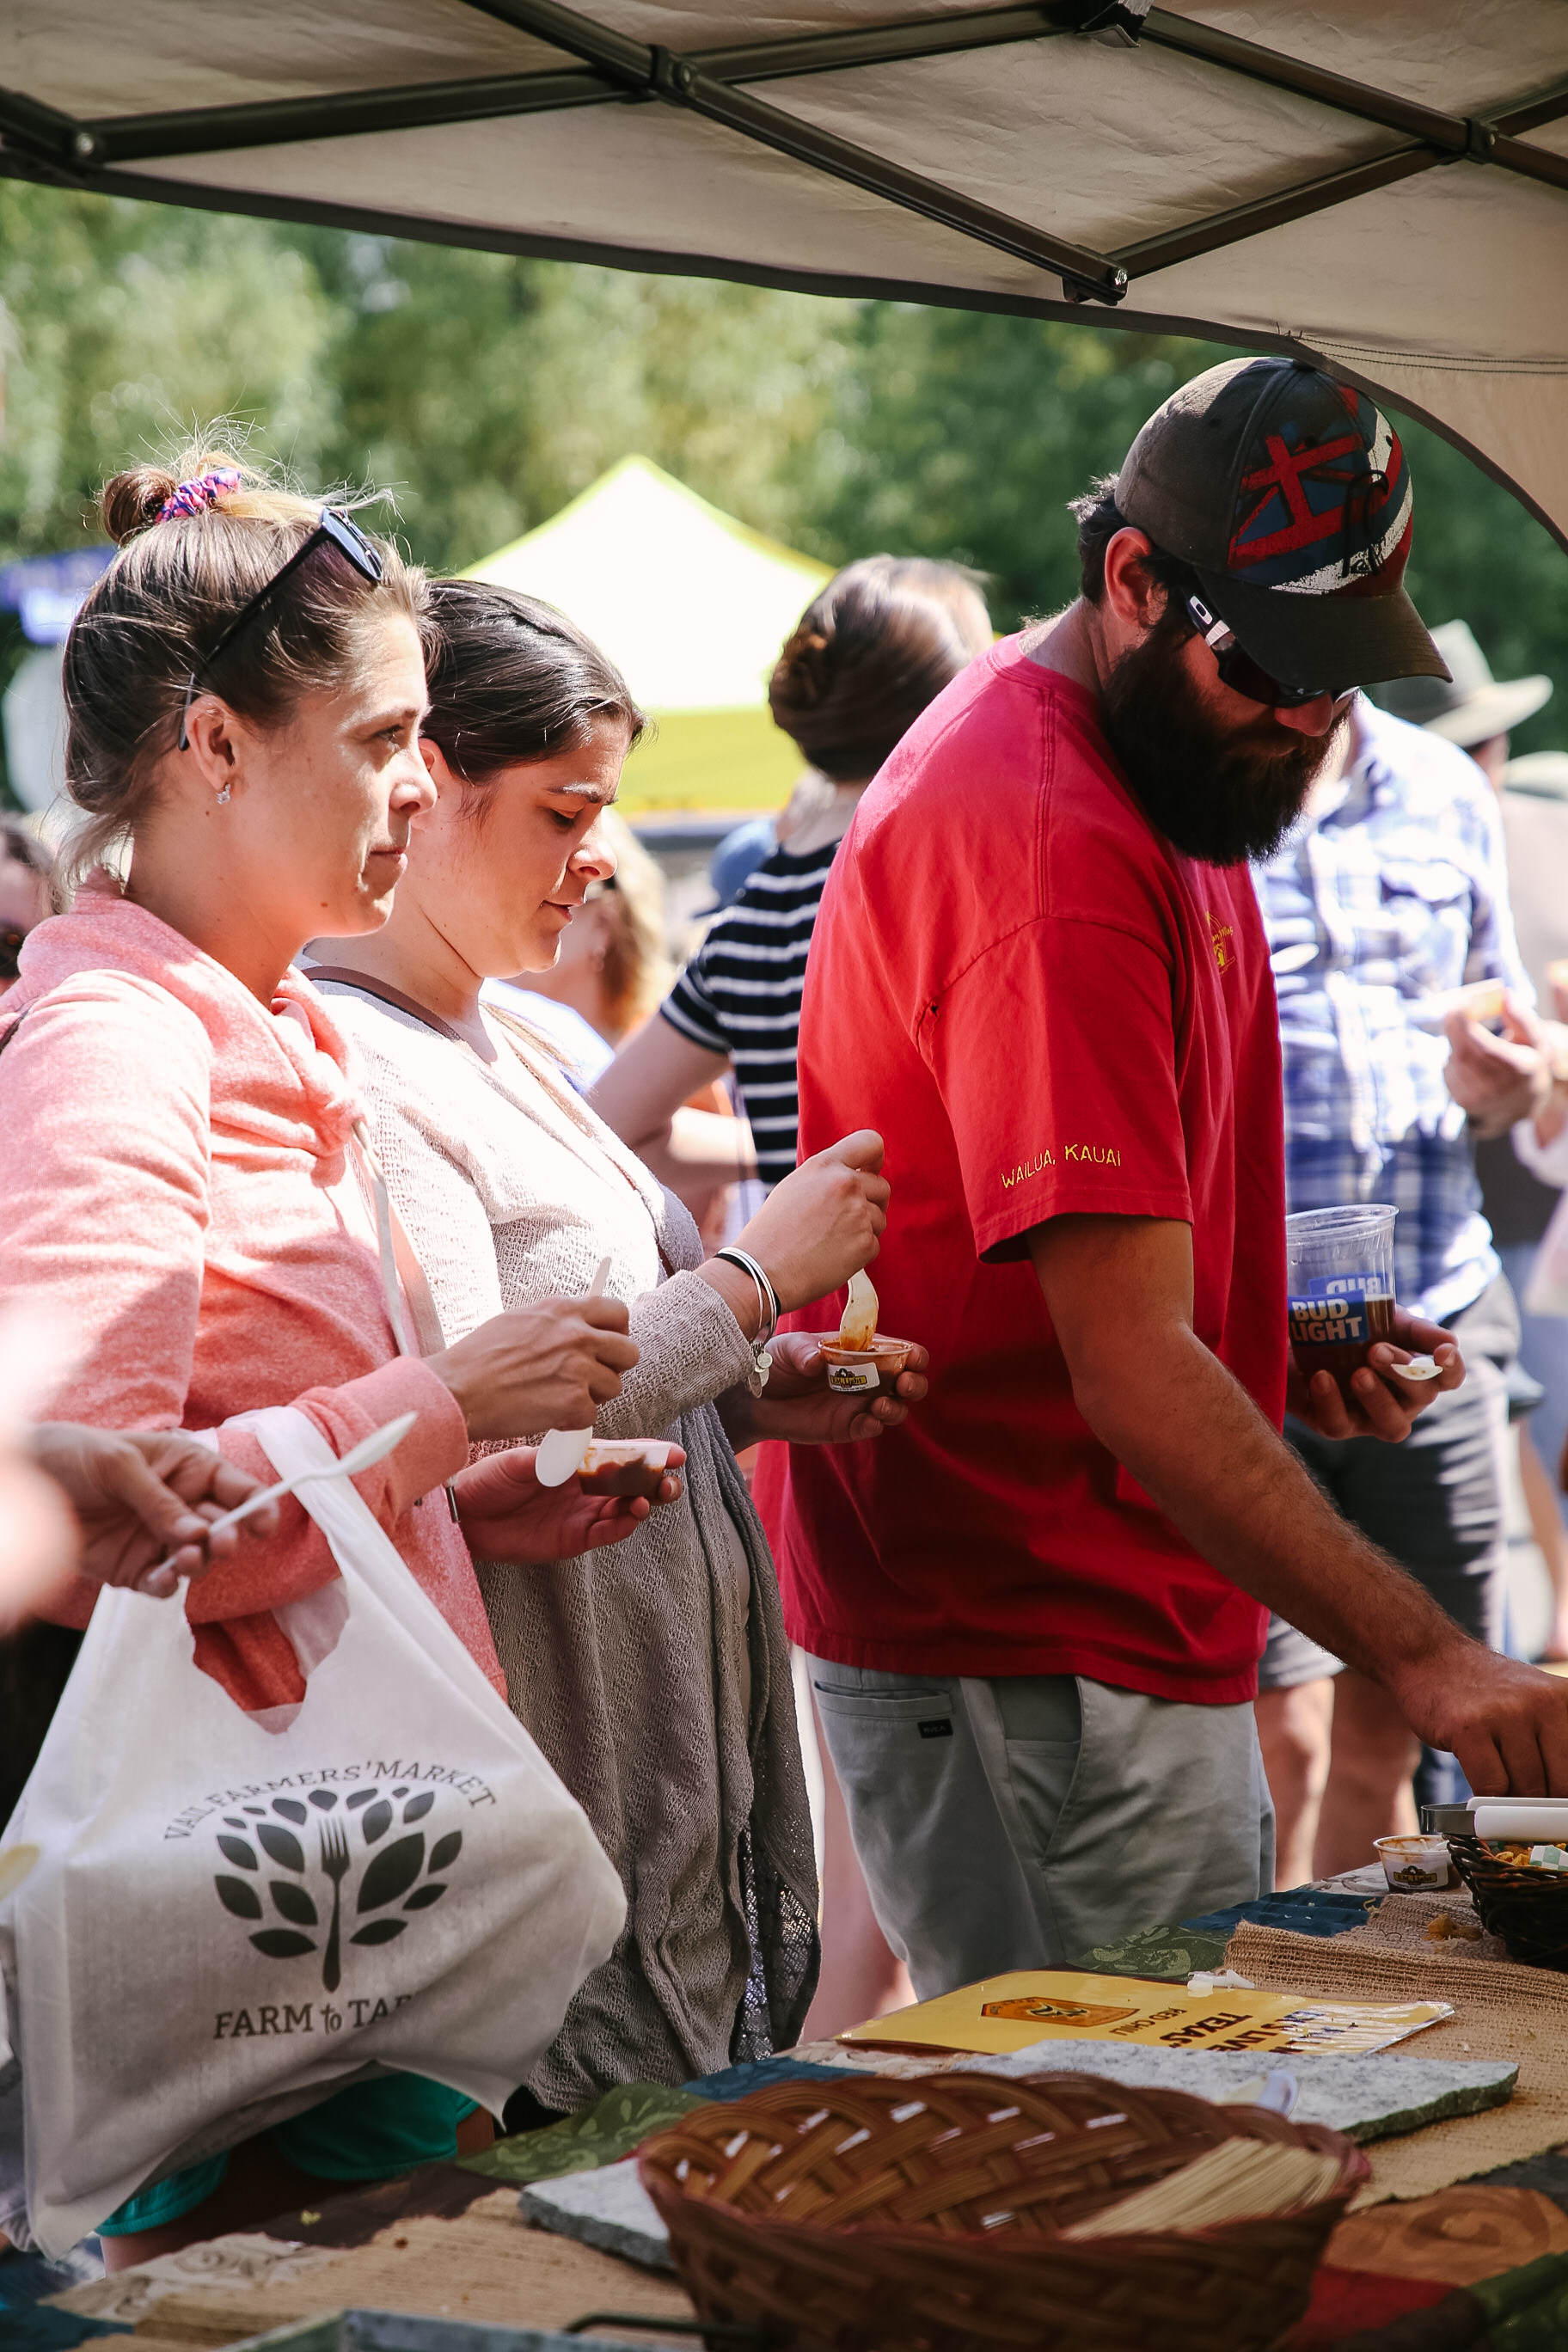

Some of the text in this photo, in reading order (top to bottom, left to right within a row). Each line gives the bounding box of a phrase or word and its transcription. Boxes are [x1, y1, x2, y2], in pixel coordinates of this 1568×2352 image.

[1001, 1143, 1121, 1189] WAILUA, KAUAI
[1292, 1299, 1349, 1321] BUD
[1290, 1317, 1362, 1341] LIGHT
[373, 1759, 497, 1810] MARKET
[213, 2002, 315, 2040] FARM
[320, 2002, 343, 2035] to
[1109, 2019, 1156, 2037] CHILI
[1205, 2030, 1278, 2052] LIVE
